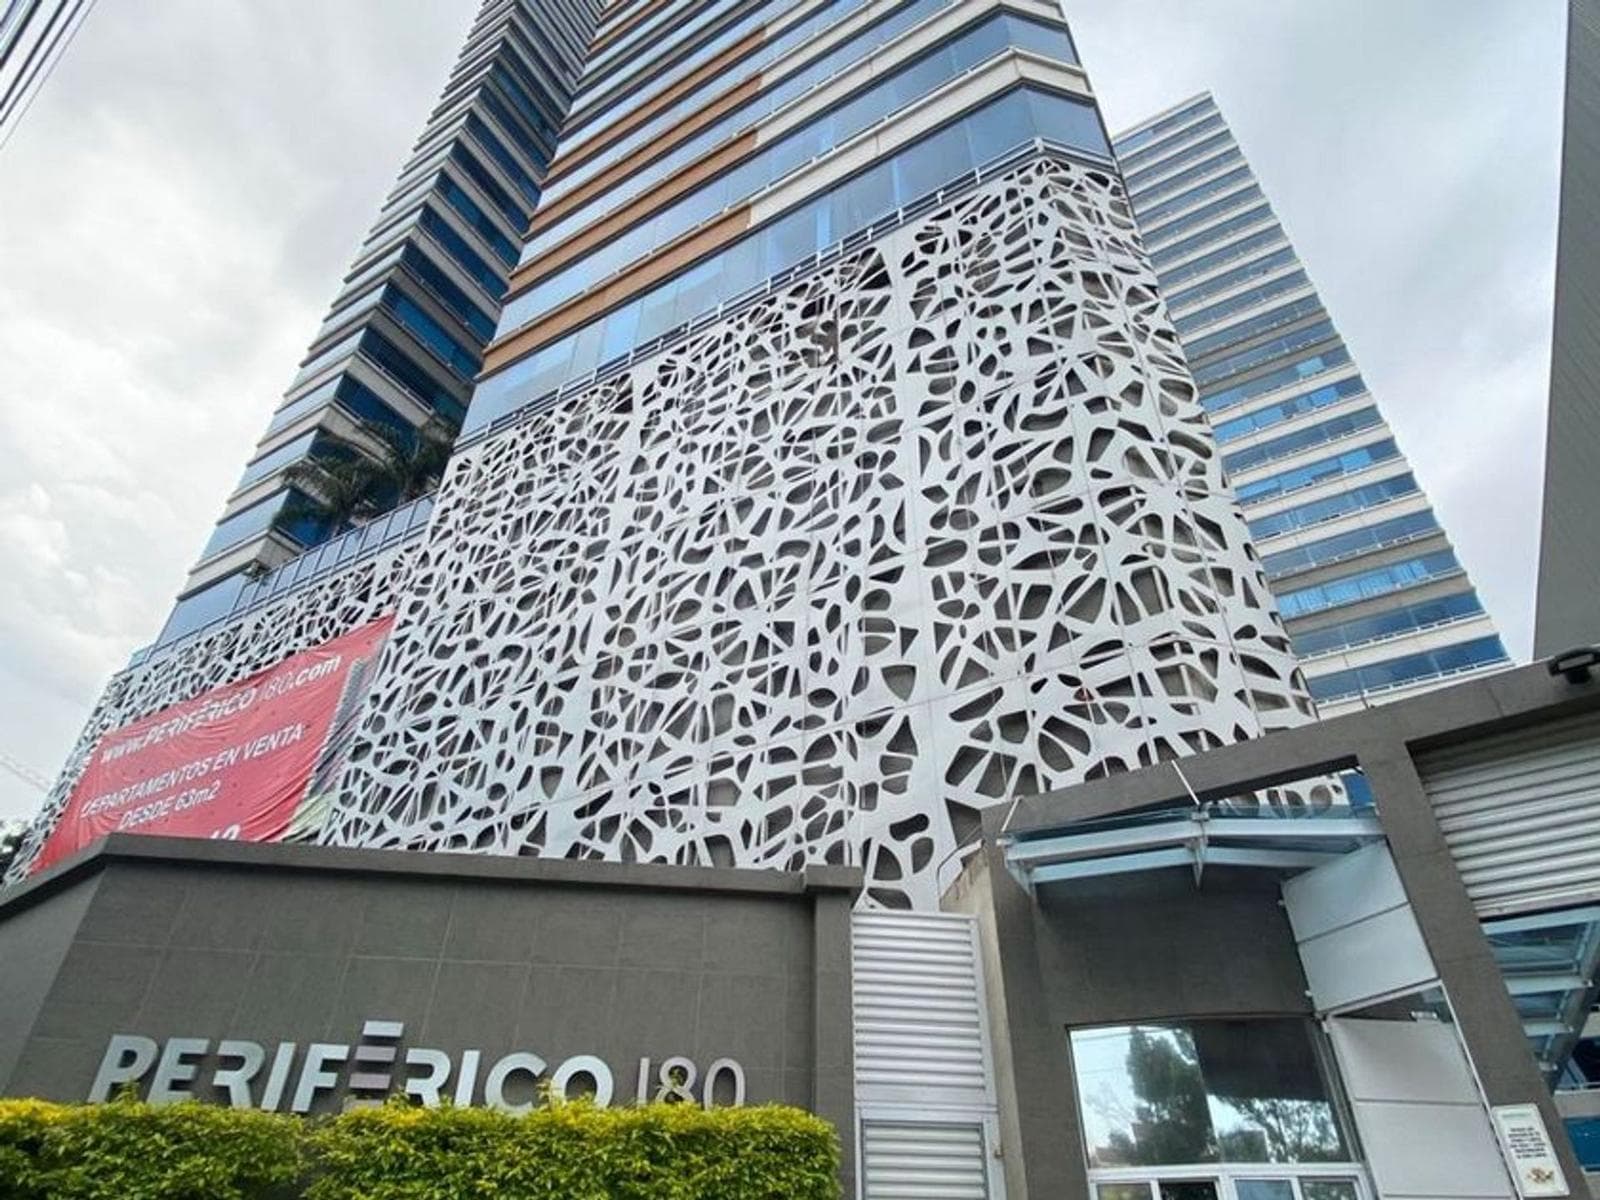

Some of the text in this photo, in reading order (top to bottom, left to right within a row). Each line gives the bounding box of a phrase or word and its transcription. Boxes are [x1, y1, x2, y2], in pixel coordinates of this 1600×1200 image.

[80, 722, 304, 819] DEPARTAMENTOS EN VENTA
[117, 794, 177, 831] DESDE
[87, 1020, 614, 1114] PERIFÉRICO
